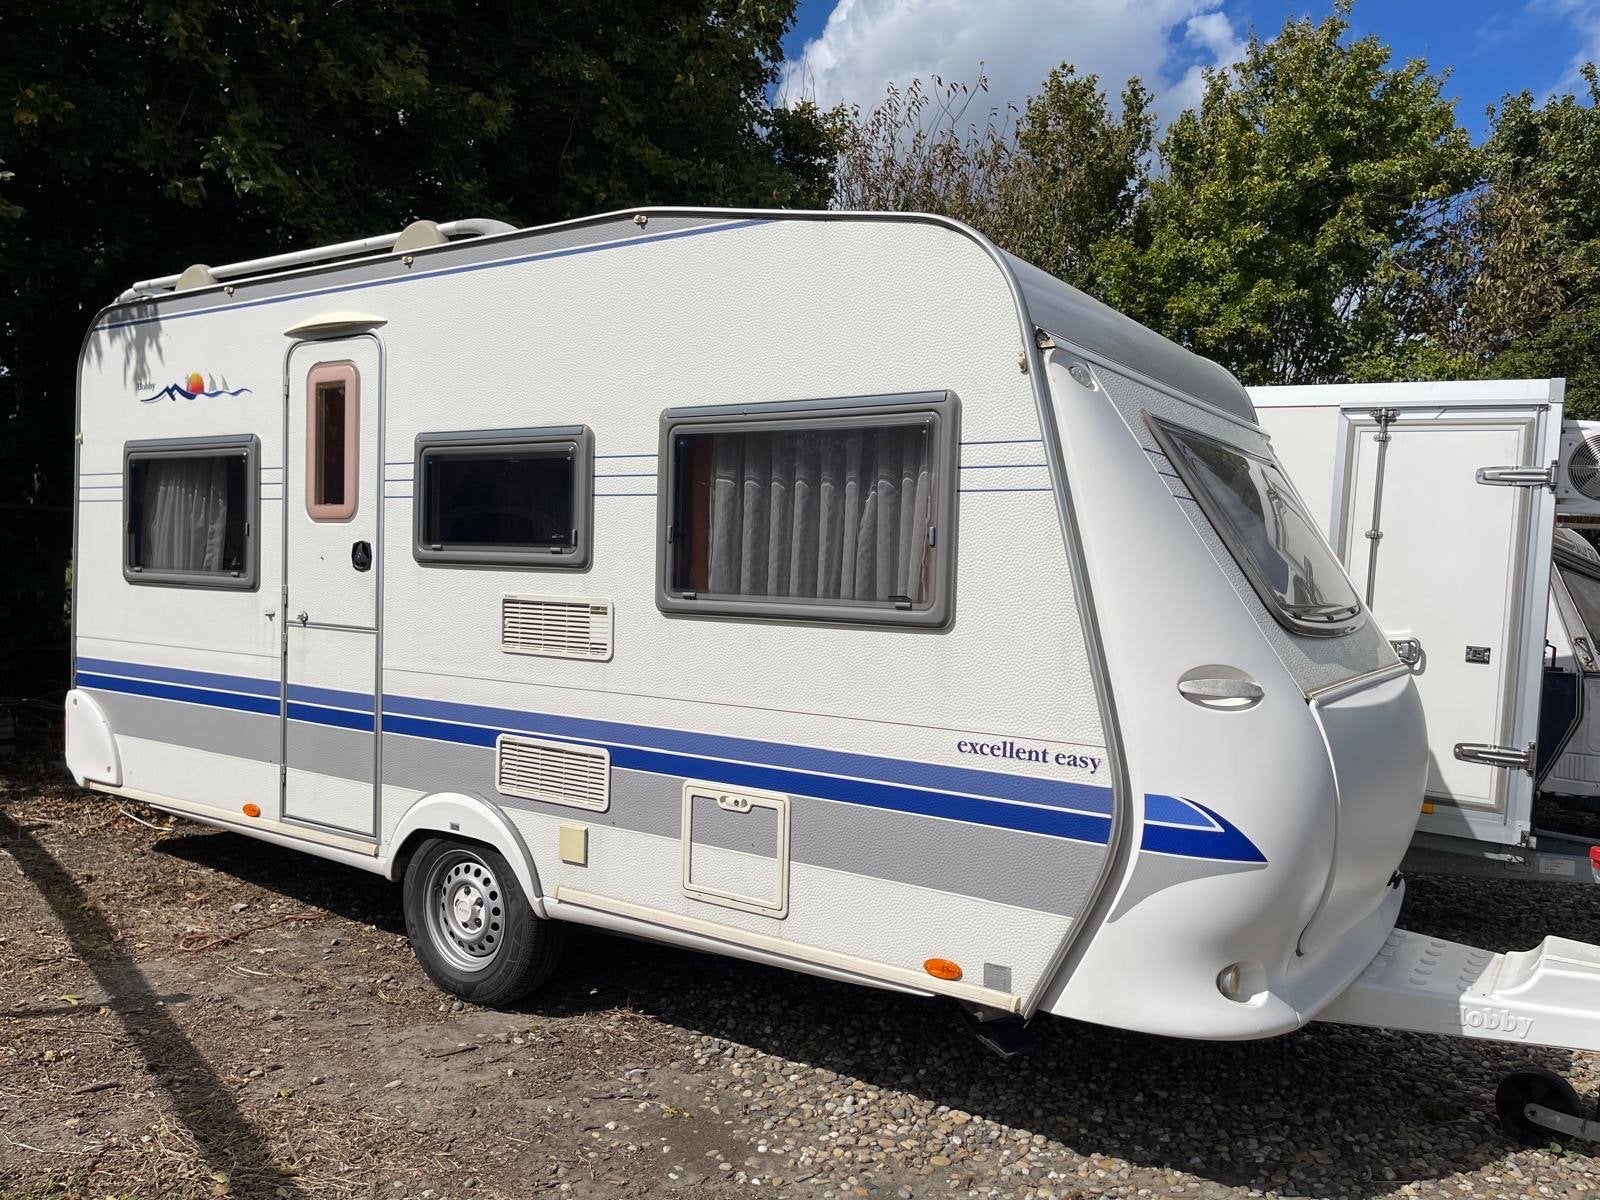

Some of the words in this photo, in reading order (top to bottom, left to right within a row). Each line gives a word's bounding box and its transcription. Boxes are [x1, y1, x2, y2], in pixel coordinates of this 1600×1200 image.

[137, 382, 155, 391] Hobby
[957, 740, 1049, 763] excellent
[1055, 752, 1101, 774] easy
